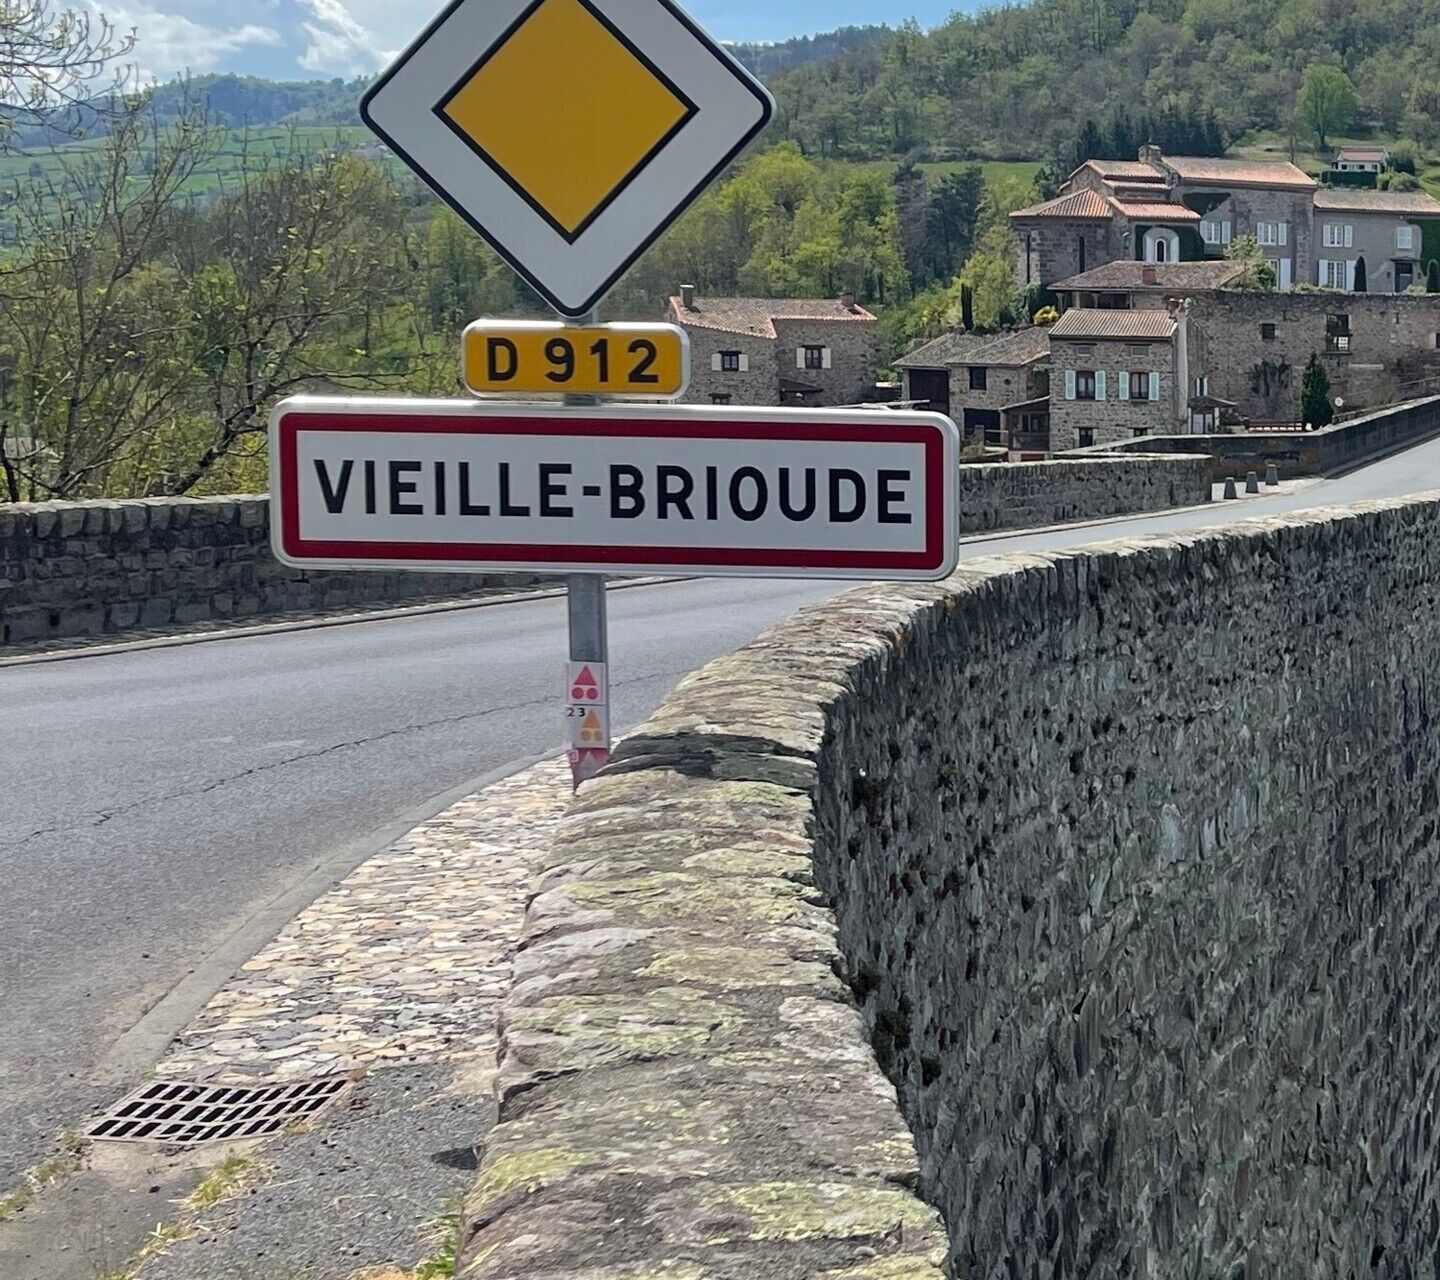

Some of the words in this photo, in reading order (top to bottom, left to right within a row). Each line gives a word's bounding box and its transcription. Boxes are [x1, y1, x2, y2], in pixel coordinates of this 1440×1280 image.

[486, 337, 519, 382] D
[544, 337, 659, 384] 912
[313, 459, 912, 525] VIEILLE-BRIOUDE
